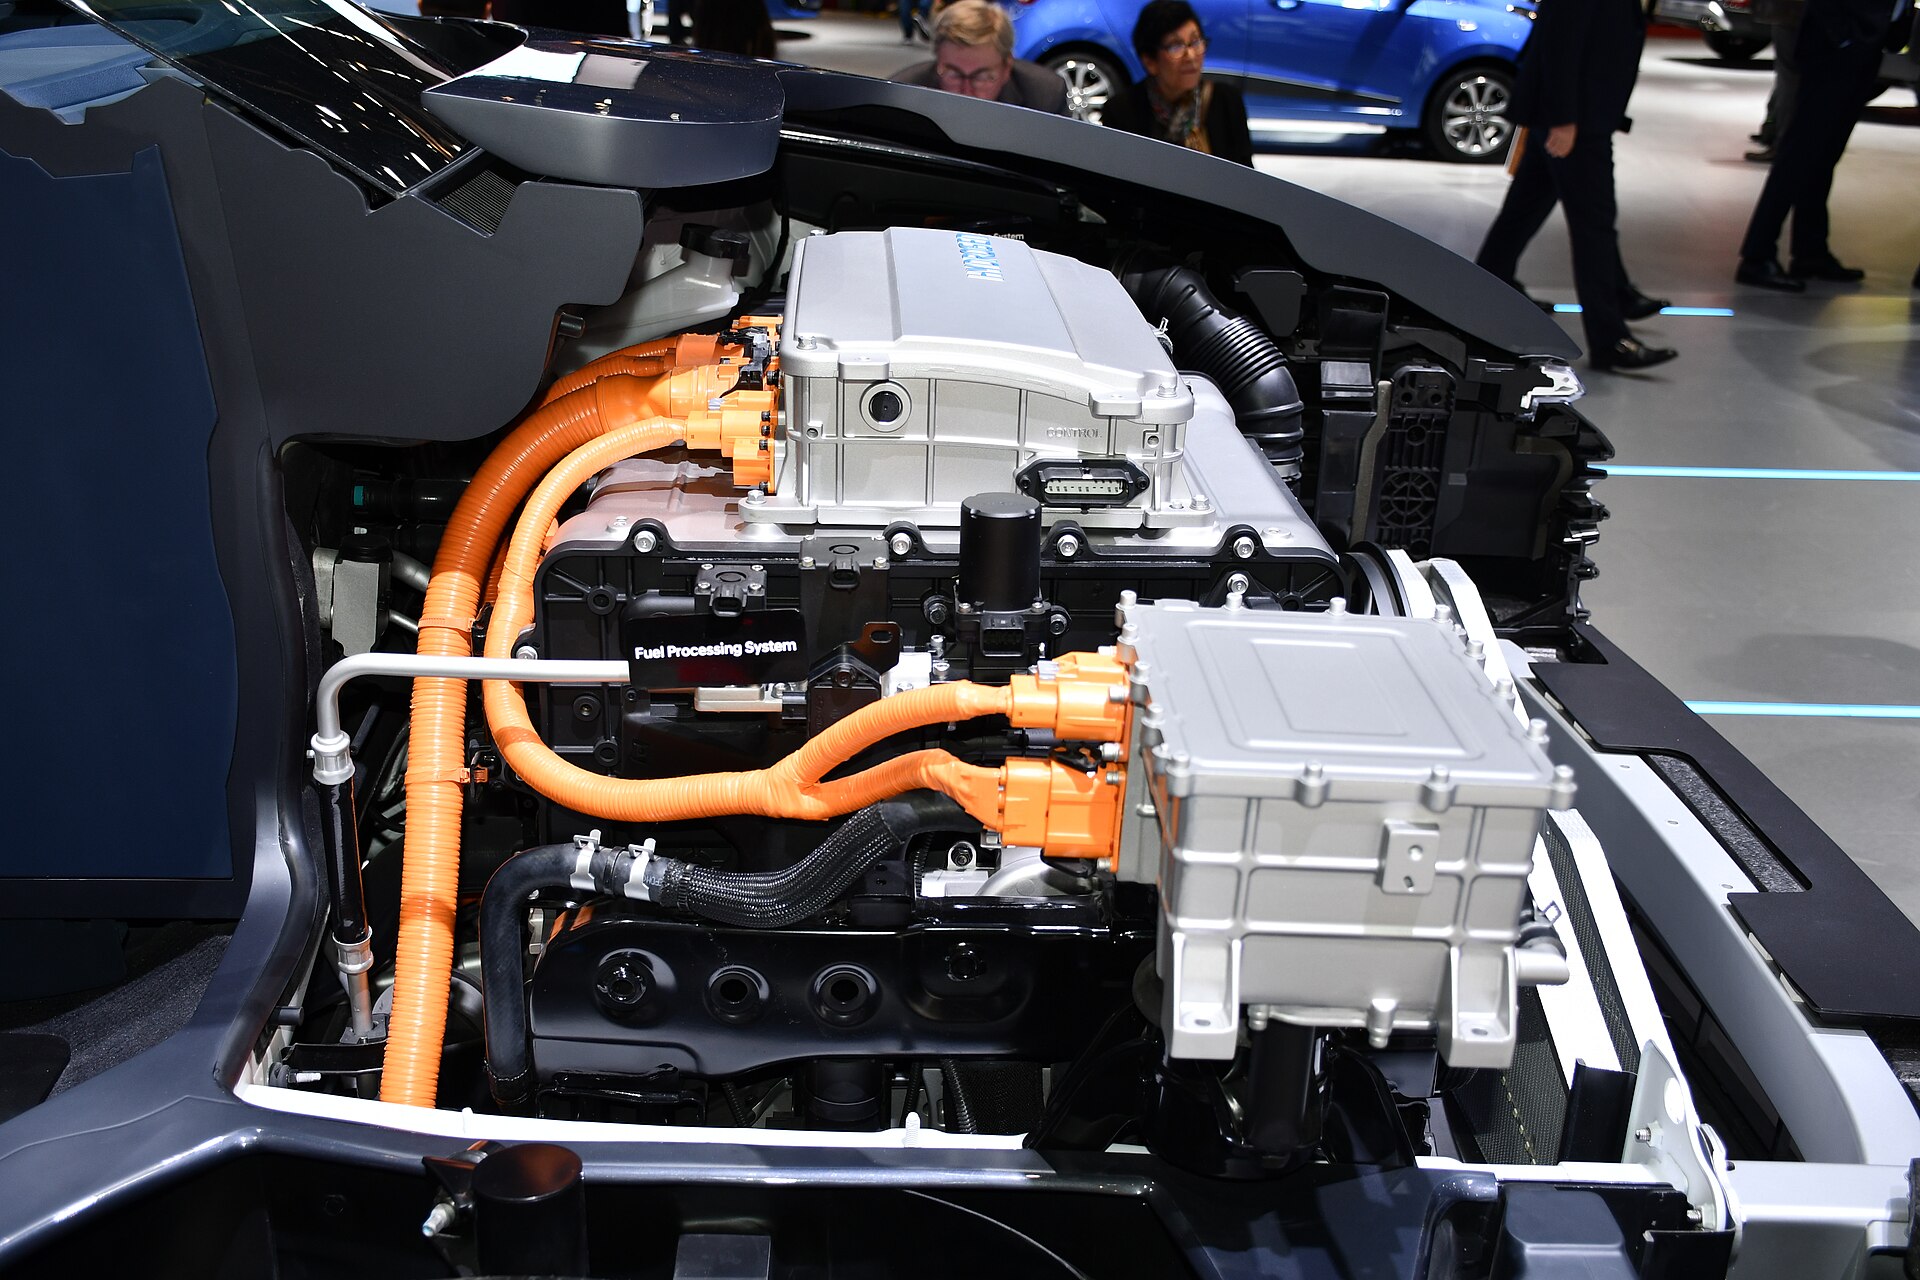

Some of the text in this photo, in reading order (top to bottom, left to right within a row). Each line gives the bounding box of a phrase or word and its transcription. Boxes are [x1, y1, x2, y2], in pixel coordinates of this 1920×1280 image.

[1046, 426, 1102, 438] CONTROL
[634, 640, 798, 660] Fuel Processing System
